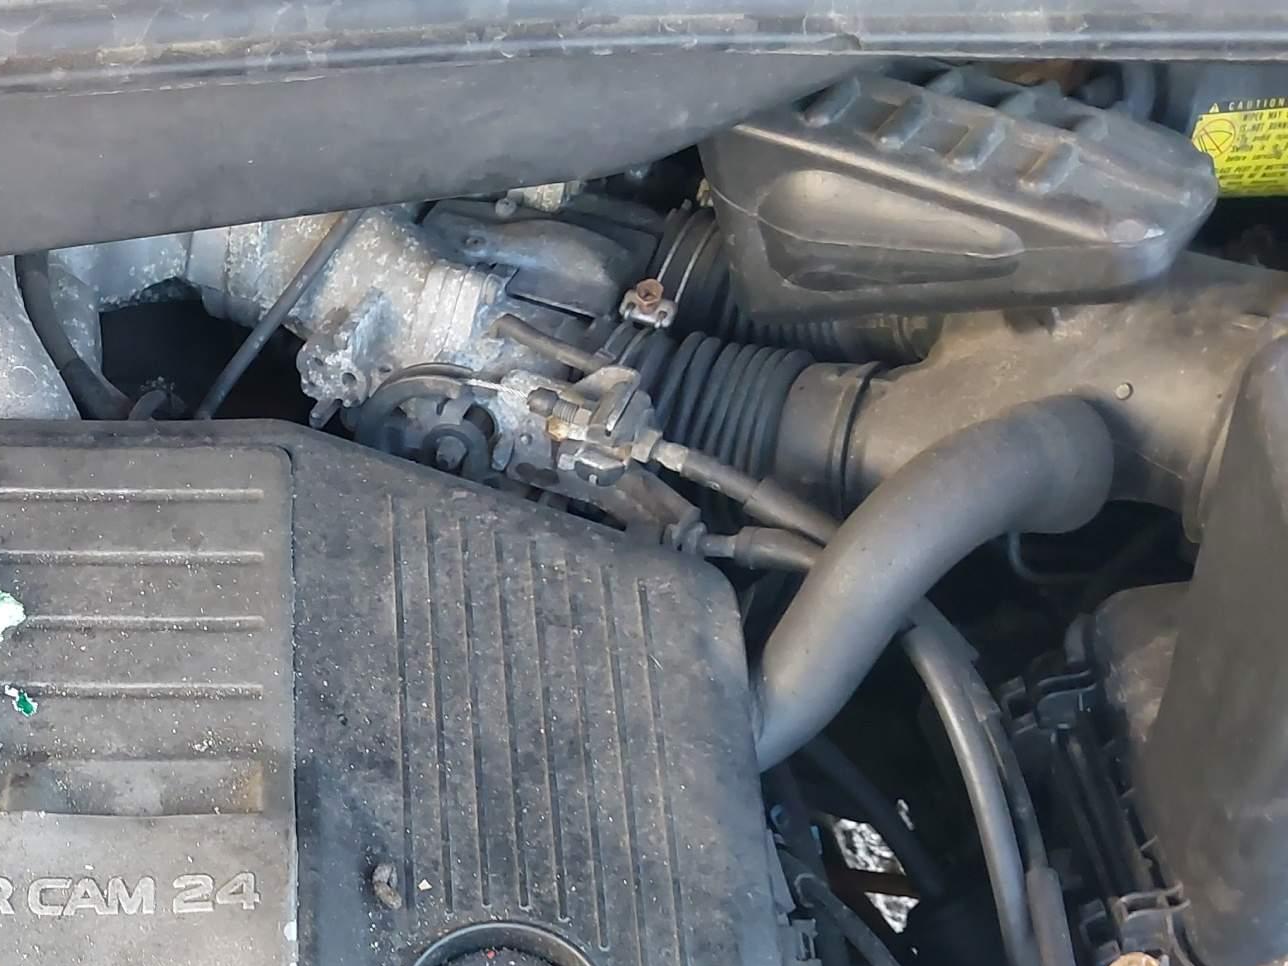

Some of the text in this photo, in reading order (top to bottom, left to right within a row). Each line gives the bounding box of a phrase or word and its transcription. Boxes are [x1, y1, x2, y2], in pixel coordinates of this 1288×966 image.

[1228, 98, 1286, 111] CAUTION
[27, 875, 156, 917] CAM
[170, 871, 260, 914] 24
